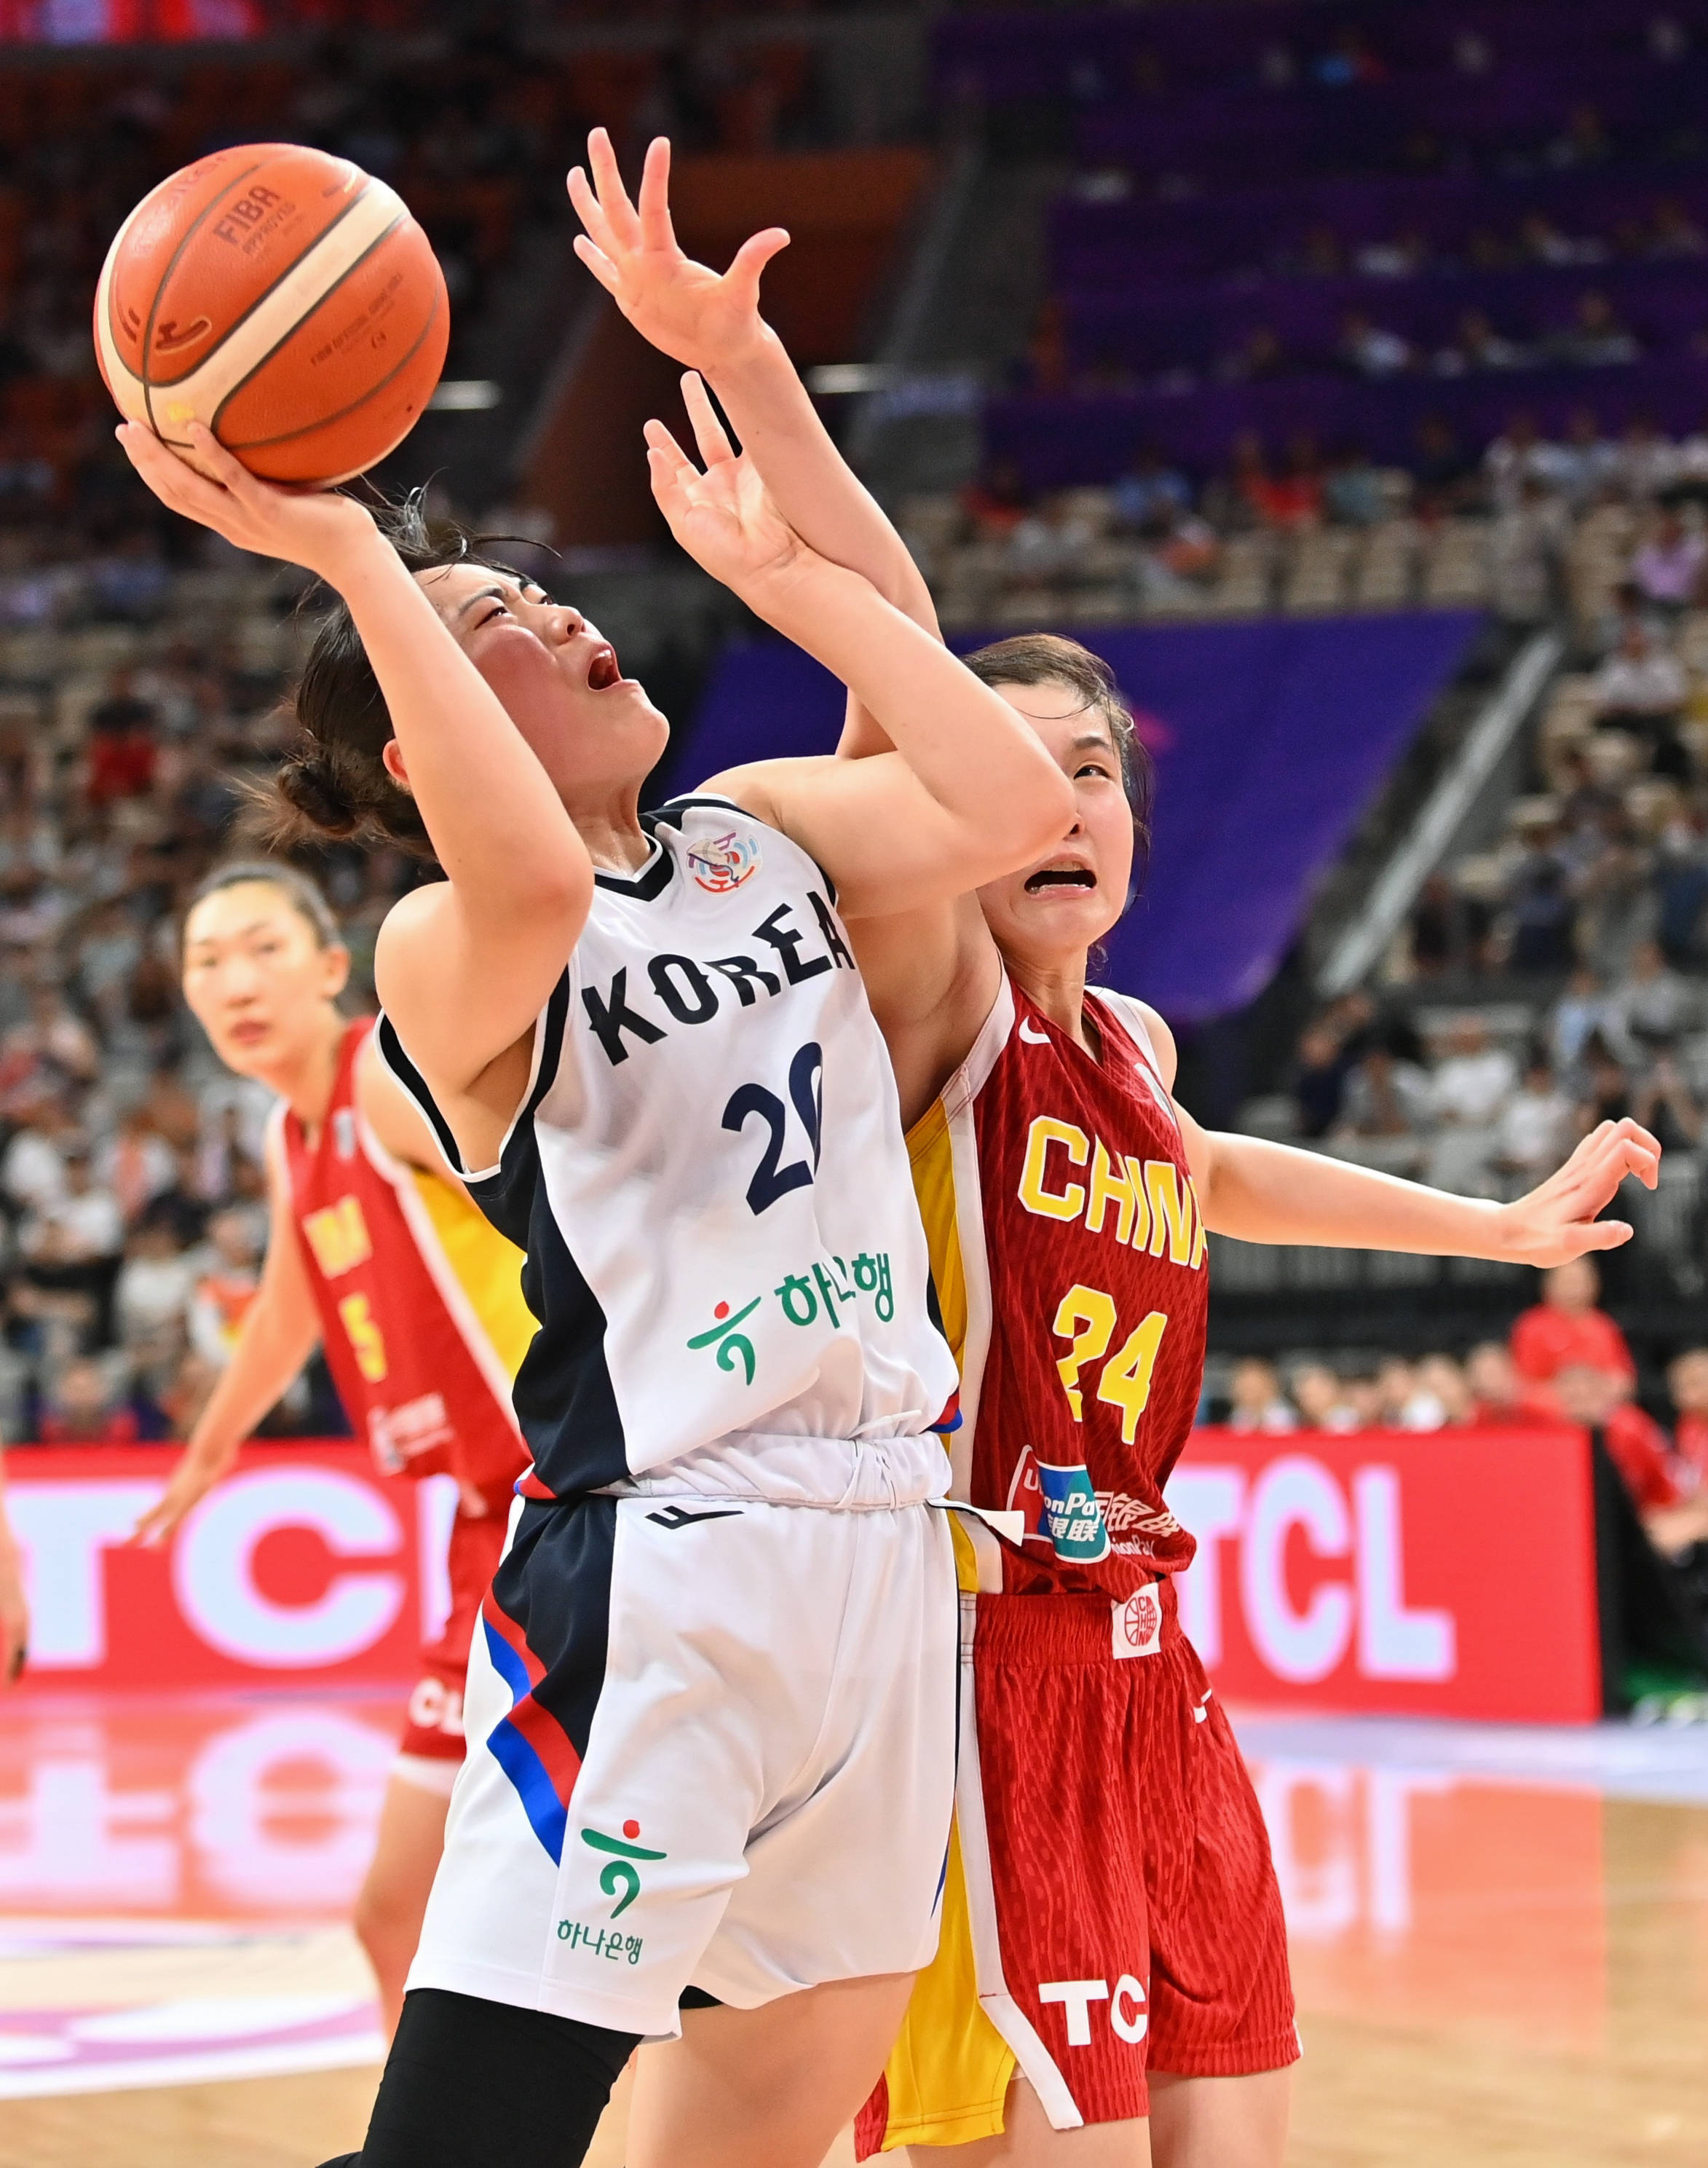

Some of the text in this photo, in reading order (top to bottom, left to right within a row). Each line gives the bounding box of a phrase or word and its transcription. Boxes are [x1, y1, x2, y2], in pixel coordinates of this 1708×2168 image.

[213, 185, 280, 244] FIBA
[581, 891, 855, 1066] KOREA
[721, 1041, 823, 1216] 20
[773, 1253, 894, 1329] 하행
[1052, 1284, 1168, 1446] 24
[1023, 1467, 1101, 1524] UonPay
[1163, 1454, 1458, 1684] TCL
[557, 1919, 643, 1965] 하나은행
[1037, 1974, 1150, 2046] TC
